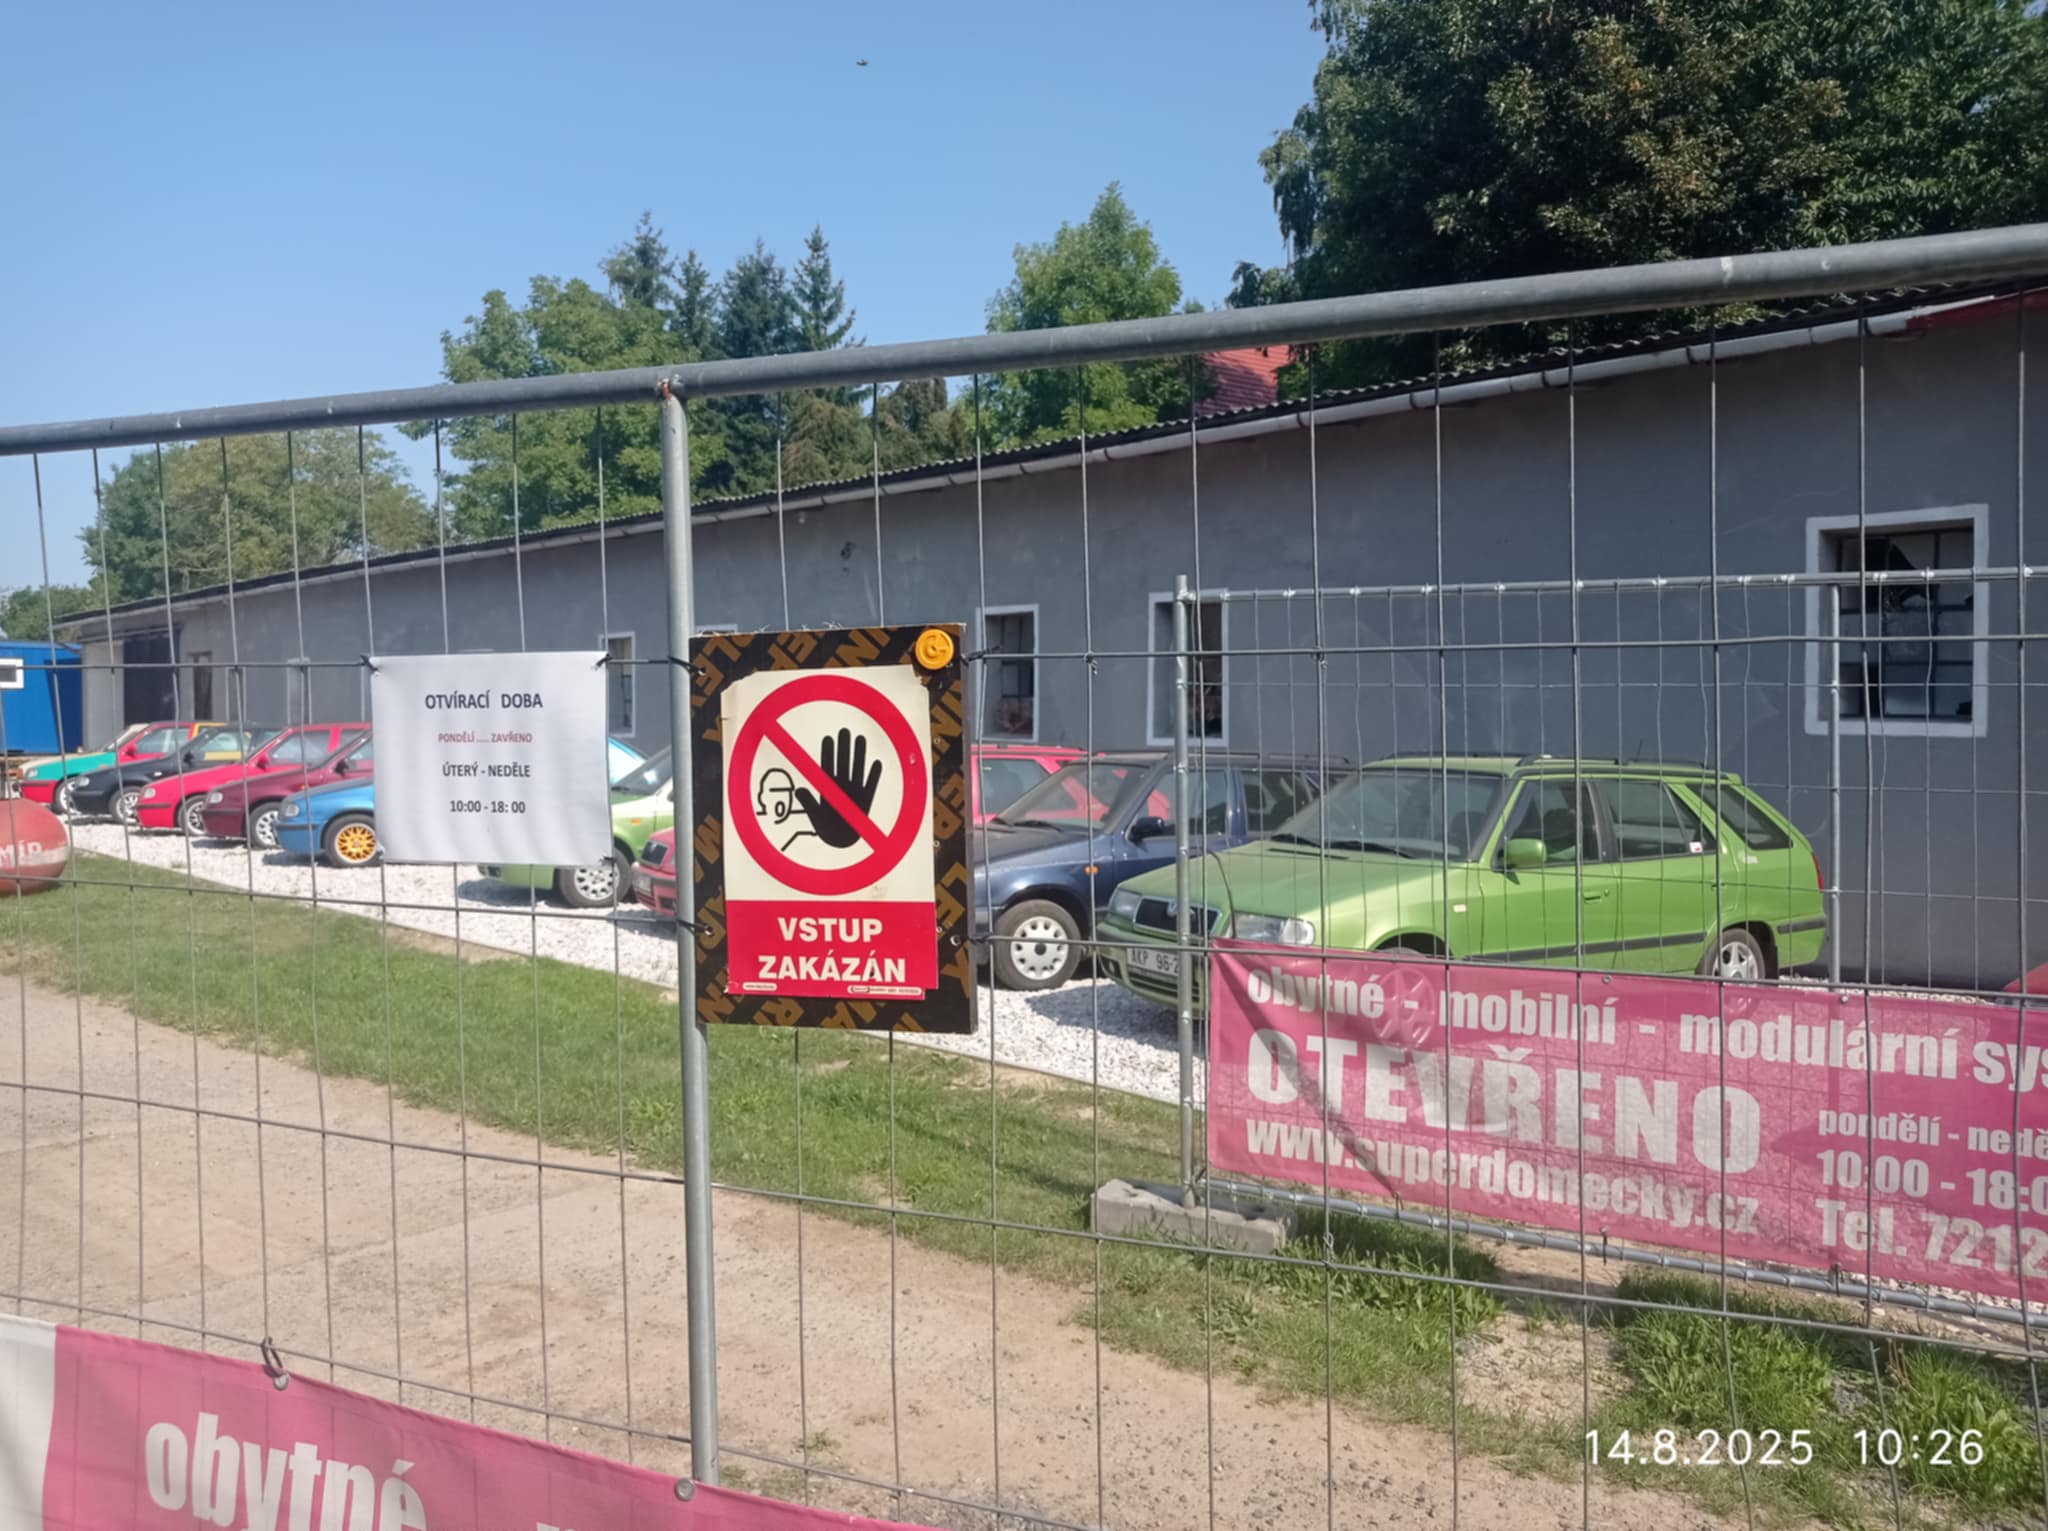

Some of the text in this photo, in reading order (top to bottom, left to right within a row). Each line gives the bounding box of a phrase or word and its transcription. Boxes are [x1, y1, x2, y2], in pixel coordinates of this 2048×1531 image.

[425, 689, 543, 709] OTVÍRACÍ DOBA
[438, 731, 475, 743] PONDĚLÍ
[491, 731, 533, 743] ZAVŘENO
[442, 761, 479, 777] ÚTERÝ
[488, 762, 531, 777] NEDĚLE
[450, 800, 481, 813] 10:00
[777, 917, 883, 943] VSTUP
[758, 949, 906, 983] ZAKÁZÁN
[1247, 966, 1385, 1019] obytné
[1438, 989, 1619, 1045] mobilní
[1679, 1014, 1960, 1079] modulární
[1973, 1040, 2048, 1092] sy
[1247, 1028, 1760, 1174] OTEVŘENO
[1818, 1109, 1942, 1147] pondělí
[1246, 1119, 1759, 1235] www.superdomecky.cz
[1816, 1149, 1930, 1198] 10:00
[1815, 1198, 1907, 1257] Tel.
